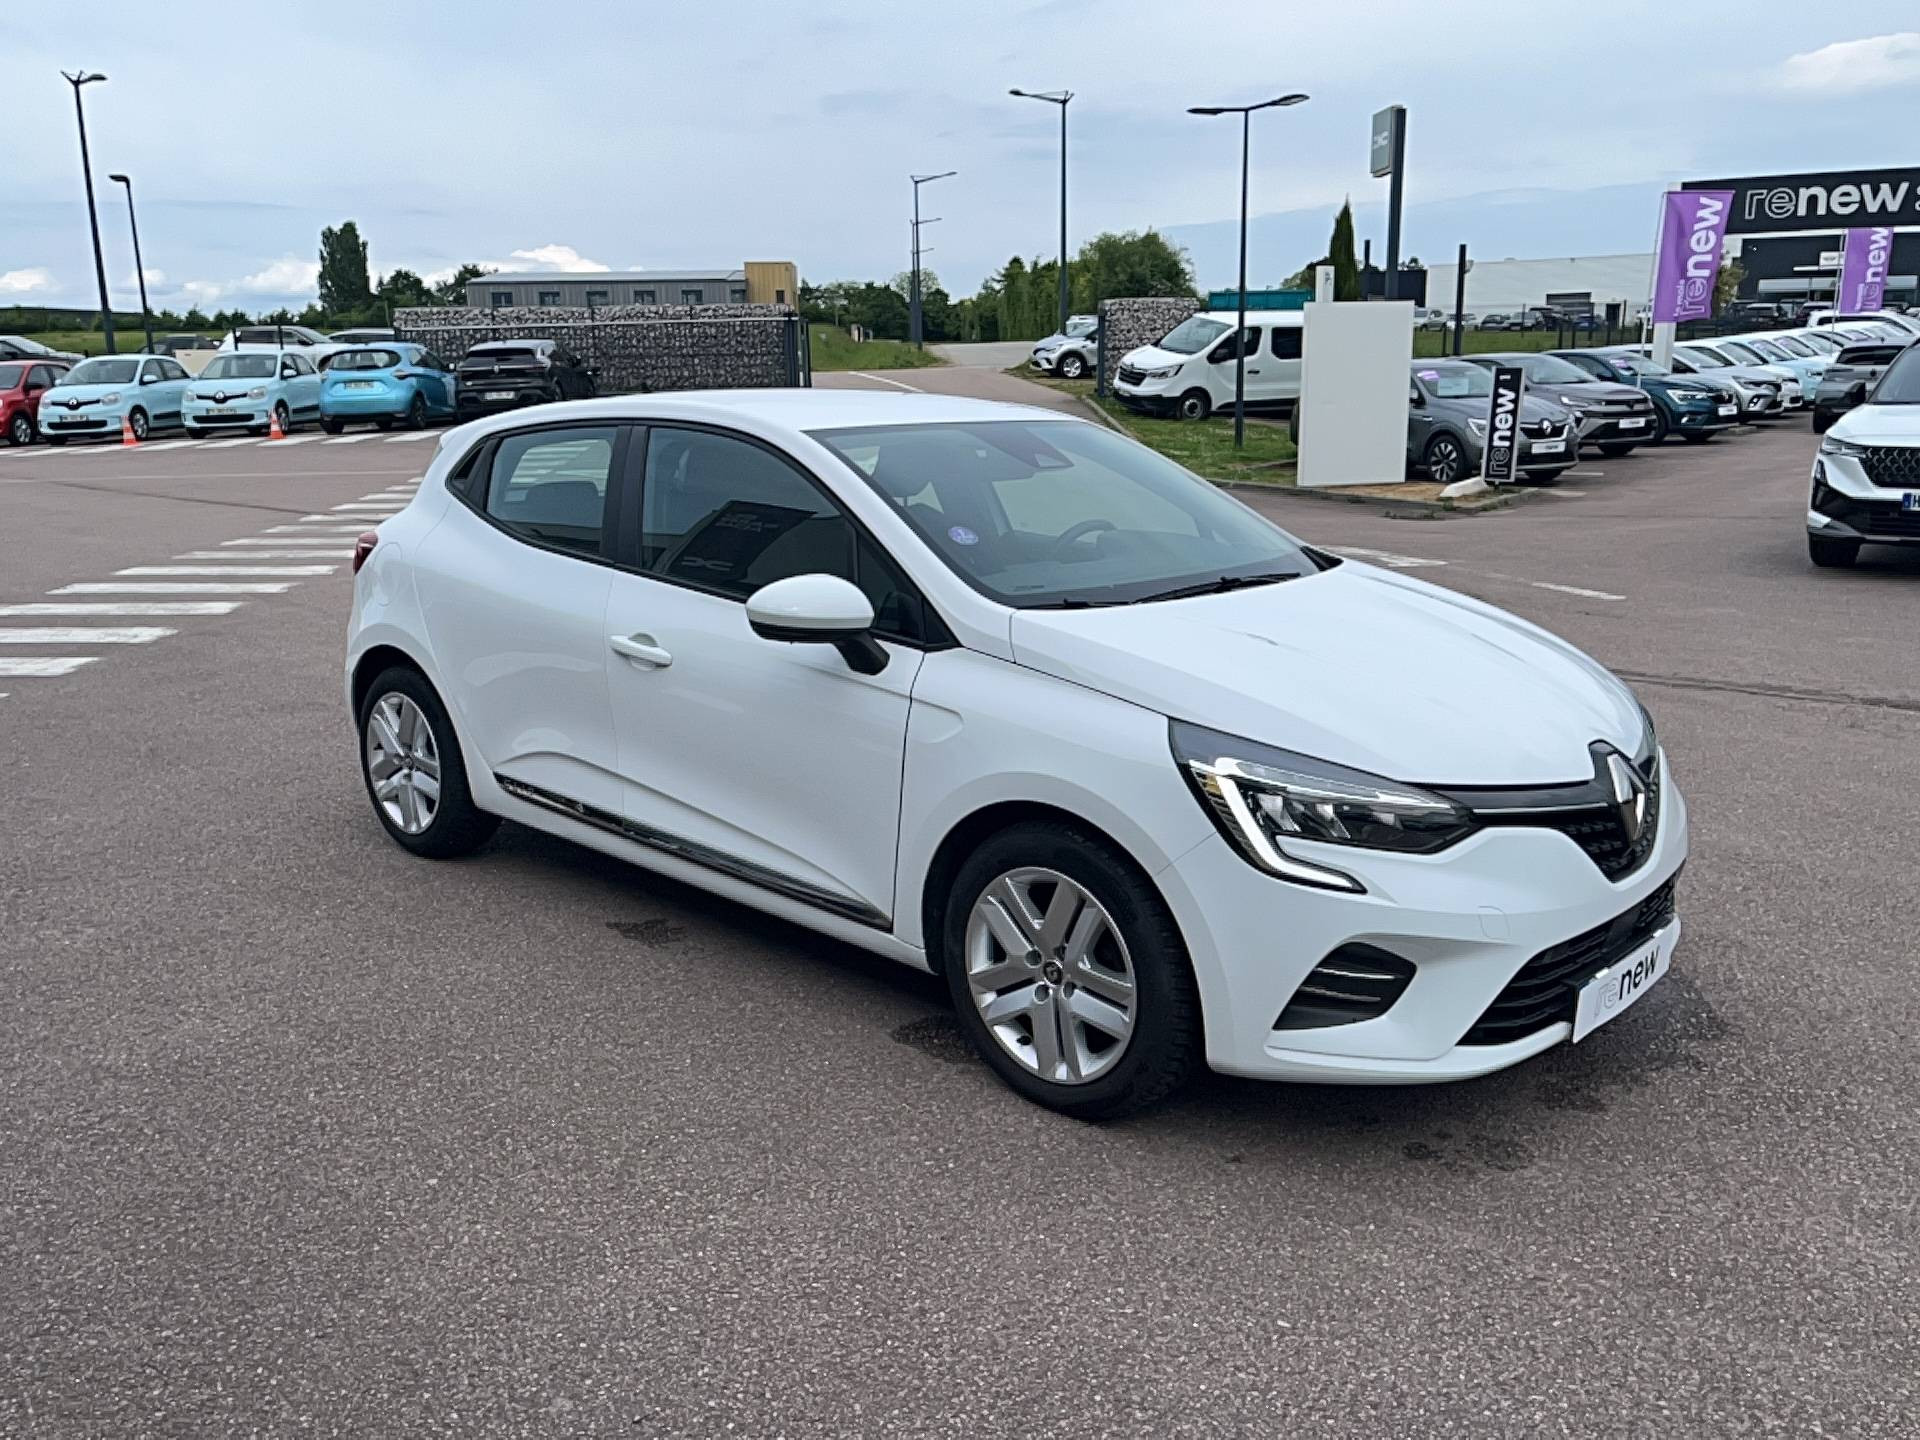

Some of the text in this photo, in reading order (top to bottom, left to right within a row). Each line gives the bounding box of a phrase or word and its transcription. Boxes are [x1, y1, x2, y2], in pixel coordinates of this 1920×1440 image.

[1744, 181, 1910, 220] renew
[1680, 196, 1724, 316] renew
[1489, 387, 1517, 475] renew
[1594, 945, 1660, 1018] renew
